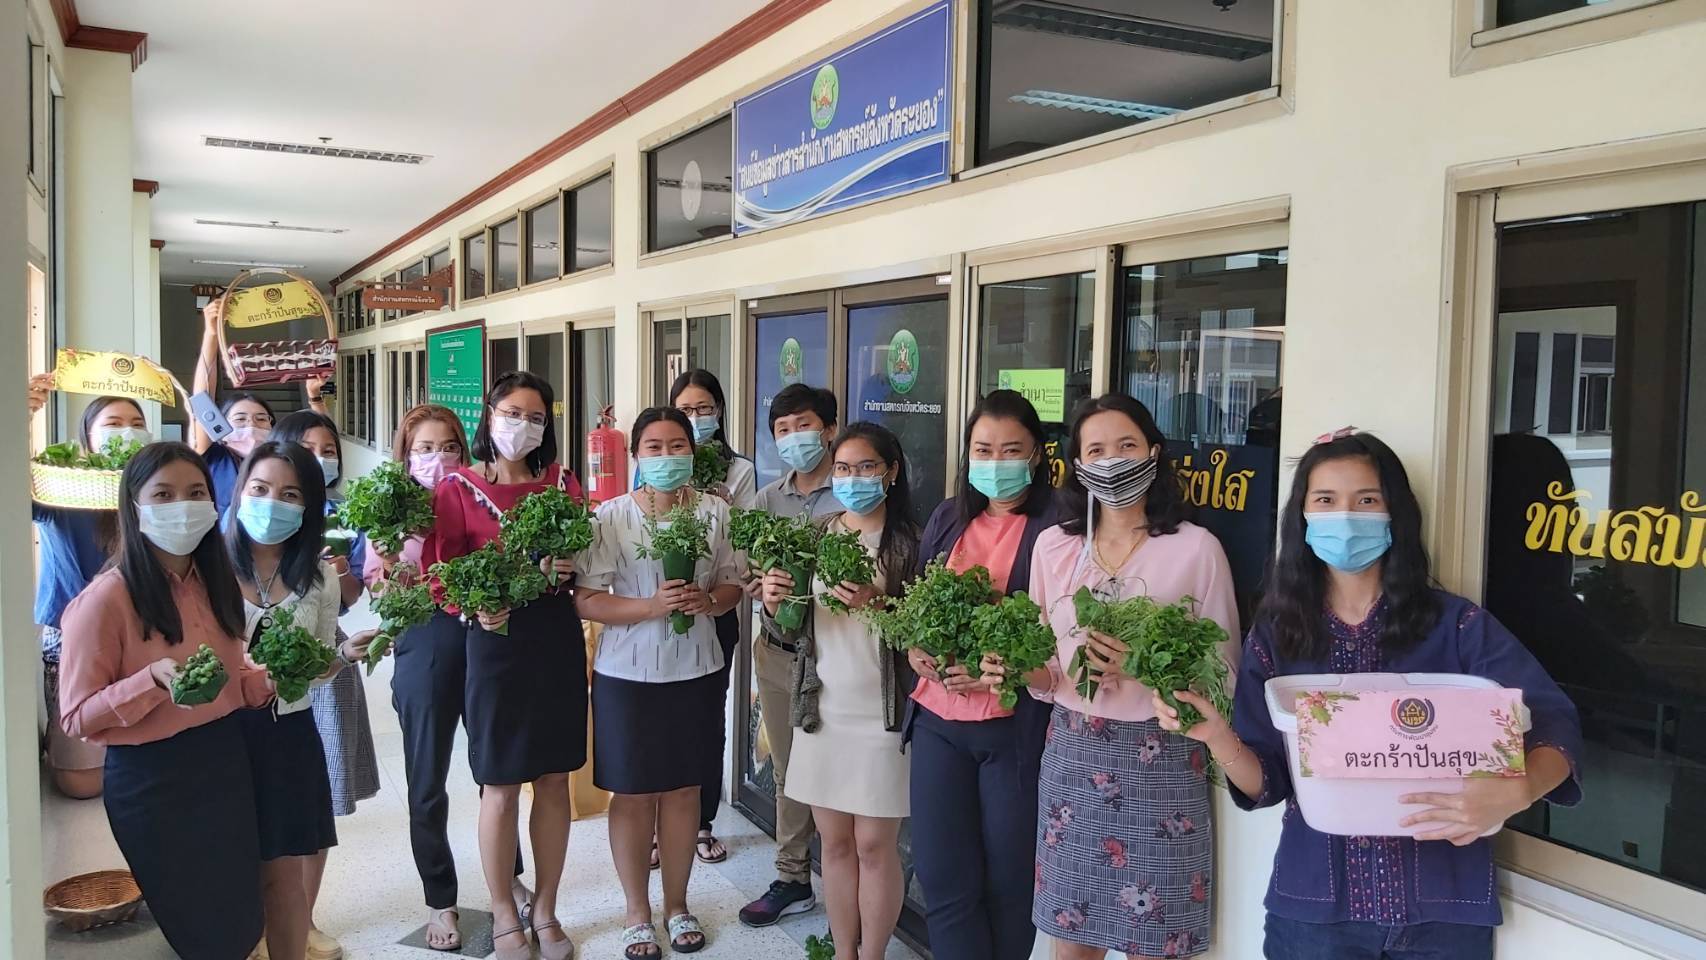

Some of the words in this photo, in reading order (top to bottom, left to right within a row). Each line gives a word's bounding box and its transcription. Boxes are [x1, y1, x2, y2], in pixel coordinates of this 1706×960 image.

[247, 305, 304, 323] ตะกร้าปันสุข
[82, 378, 153, 398] ตะกร้าปันสุข
[1344, 743, 1478, 776] ตะกร้าปันสุข
